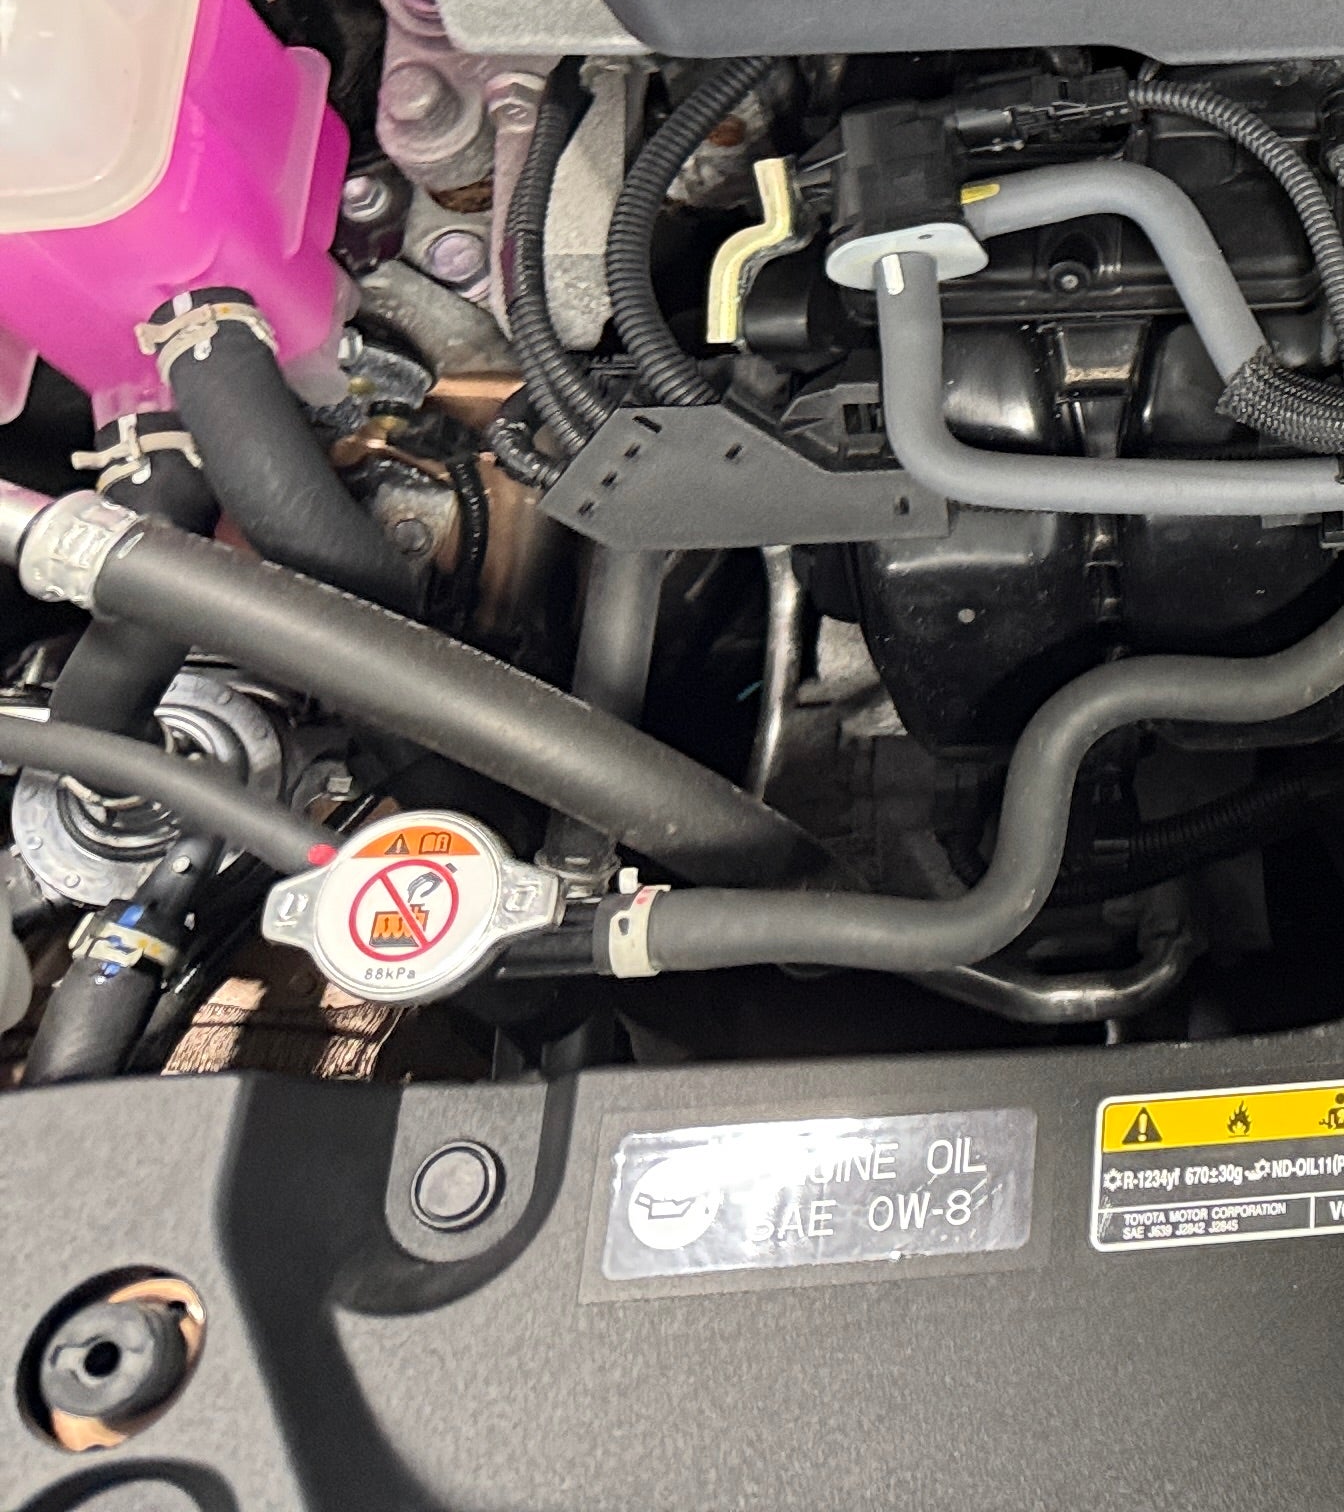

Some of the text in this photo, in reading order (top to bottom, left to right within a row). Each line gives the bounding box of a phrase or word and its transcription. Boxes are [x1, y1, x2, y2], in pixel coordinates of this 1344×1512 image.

[364, 967, 416, 981] 88kPa
[926, 1136, 988, 1176] OIL
[1123, 1168, 1180, 1190] R-1234yf
[1185, 1163, 1243, 1186] 670±30g
[746, 1199, 837, 1242] SAE
[1123, 1202, 1287, 1226] TOYOTA MOTOR CORPORATION
[1123, 1226, 1145, 1240] SAE
